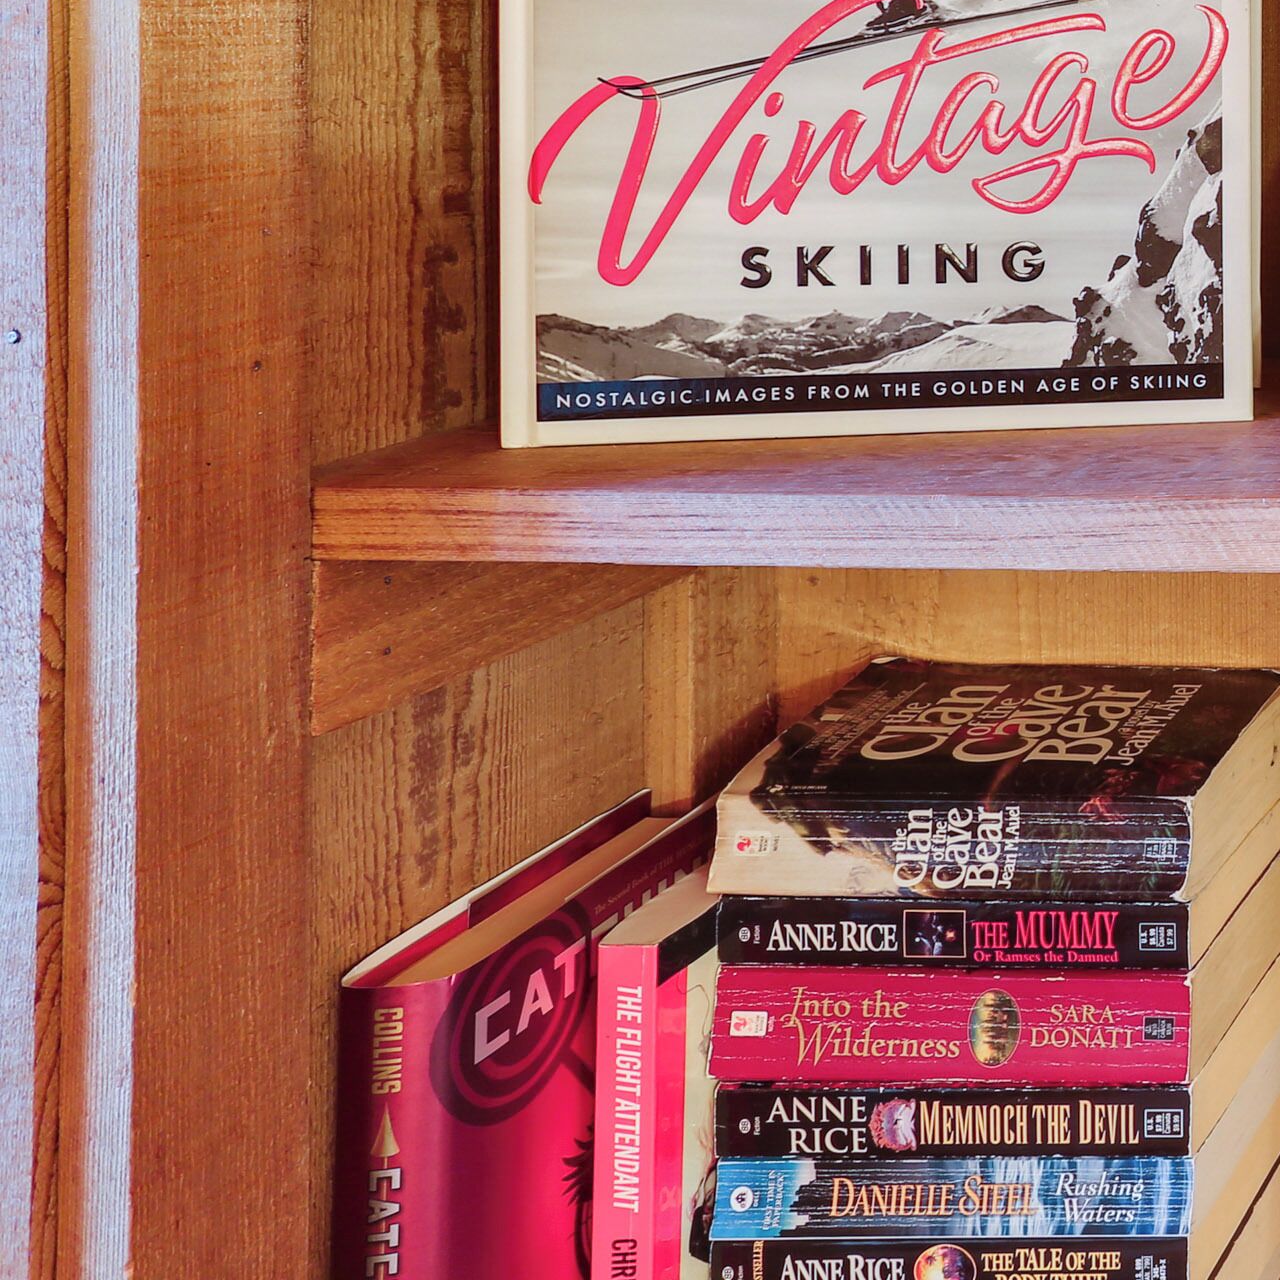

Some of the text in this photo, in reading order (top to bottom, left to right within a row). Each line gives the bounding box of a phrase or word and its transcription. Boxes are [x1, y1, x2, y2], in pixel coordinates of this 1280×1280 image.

[740, 240, 1046, 289] SKIING
[556, 373, 1209, 408] NOSTALGIC IMAGES FROM THE GOLDEN AGE OF SKIING
[860, 684, 1011, 761] Clan
[951, 684, 1095, 763] Cave
[1022, 684, 1154, 765] Bear
[1105, 728, 1156, 766] Jean
[890, 828, 907, 851] the
[1006, 806, 1021, 835] Auel
[892, 808, 934, 888] Clan
[930, 822, 946, 861] of the
[932, 808, 973, 889] Cave
[963, 806, 1004, 888] Bear
[997, 853, 1017, 889] Jean
[766, 919, 899, 952] ANNE RICE
[971, 911, 1120, 950] THE MUMMY
[973, 949, 1120, 963] Or Ramses the Damned
[474, 936, 586, 1066] CAT
[780, 986, 910, 1028] Into the
[1049, 1004, 1115, 1024] SARA
[371, 1007, 404, 1096] COLLINS
[793, 1020, 961, 1067] Wilderness
[1030, 1028, 1134, 1049] DONATI
[612, 985, 643, 1214] THE FLIGHT ATTENDANT
[766, 1096, 867, 1123] ANNE
[788, 1128, 868, 1154] RICE
[919, 1099, 1140, 1145] MEMNOCH THE DEVIL
[829, 1175, 1038, 1217] DANIELLE STEEL
[1055, 1171, 1146, 1201] Rushing
[1063, 1197, 1136, 1223] Waters
[781, 1255, 905, 1280] ANNE RICE
[981, 1248, 1121, 1272] THE TALE OF THE
